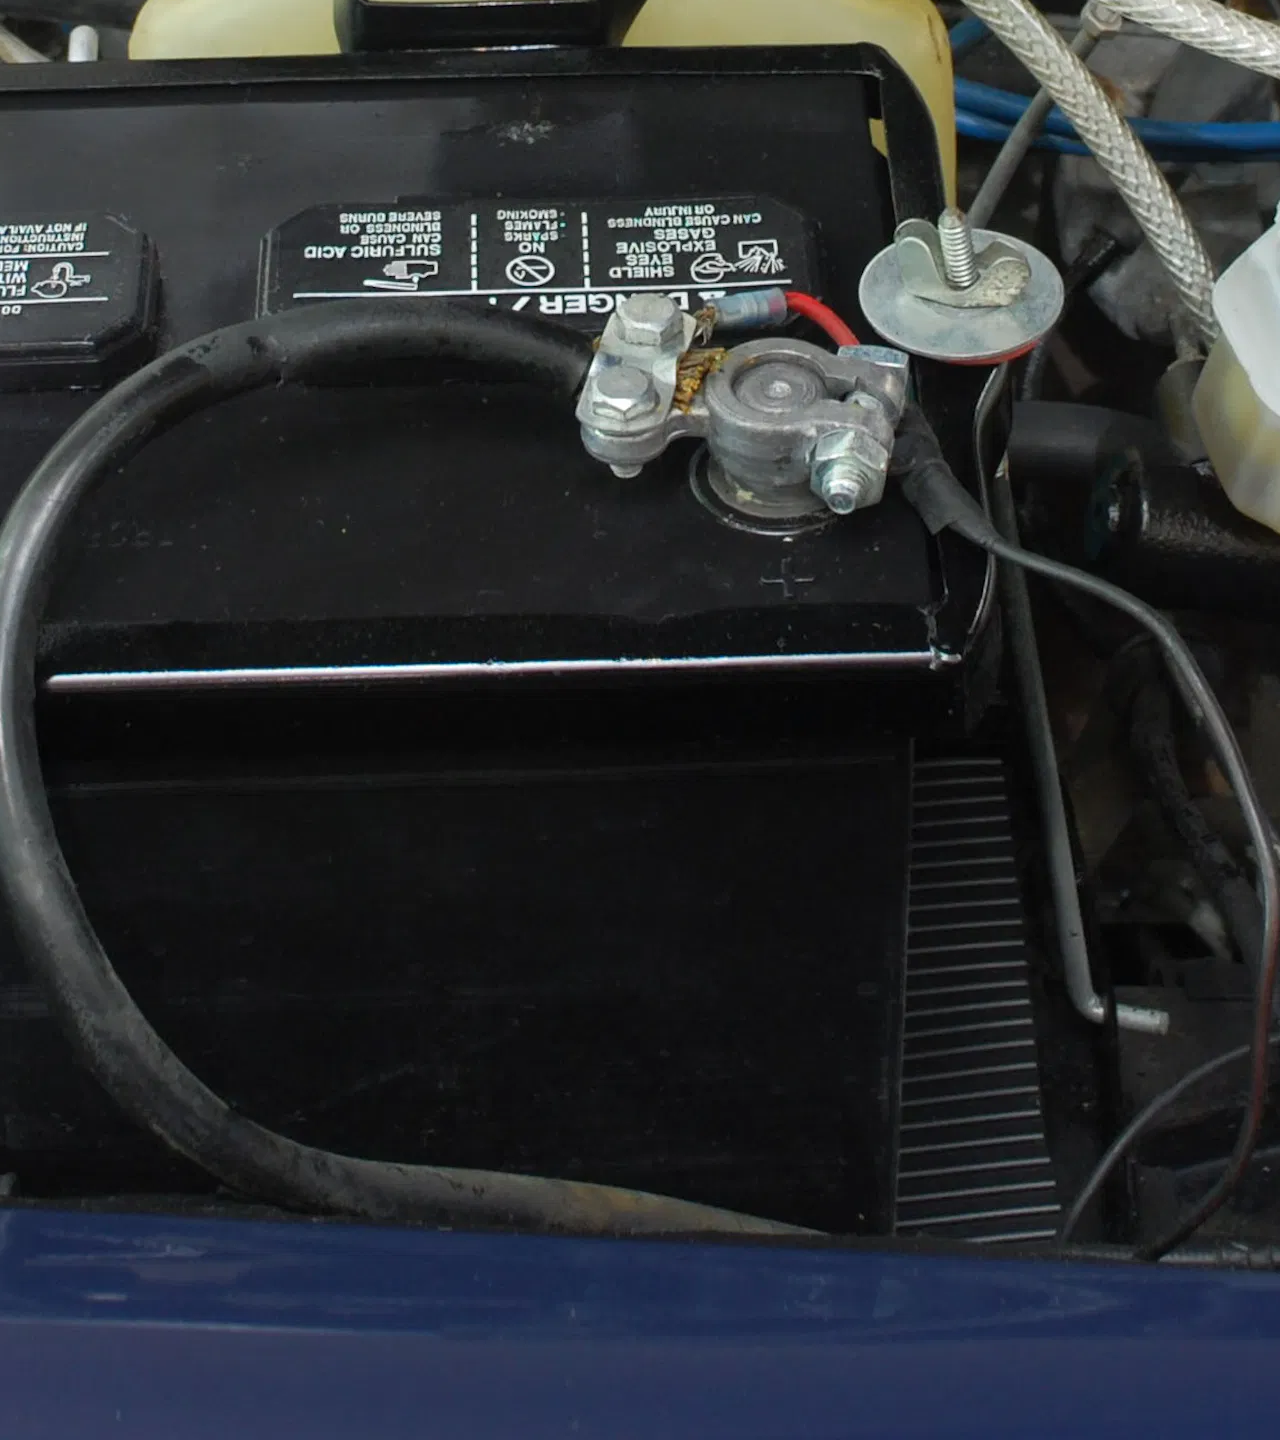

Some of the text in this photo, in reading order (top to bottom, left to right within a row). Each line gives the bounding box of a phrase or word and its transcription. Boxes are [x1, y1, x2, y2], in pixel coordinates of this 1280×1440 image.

[497, 209, 558, 220] SMOKING
[644, 205, 715, 216] OR INJURY
[390, 211, 441, 223] SEVERE
[608, 213, 762, 228] CAN CAUSE BLINDNESS
[48, 223, 72, 234] NOT
[340, 222, 442, 235] BLINDNESS OR
[505, 220, 558, 231] FLAMES
[360, 233, 442, 245] CAN CAUSE
[504, 231, 559, 242] SPARKS
[654, 227, 716, 241] GASES
[304, 244, 441, 260] SULFURIC ACID
[519, 242, 546, 254] NO
[616, 240, 716, 254] EXPLOSIVE
[626, 253, 673, 266] EYES
[610, 266, 675, 279] SHIELD
[540, 291, 689, 315] DNGER
[2, 306, 22, 315] DO
